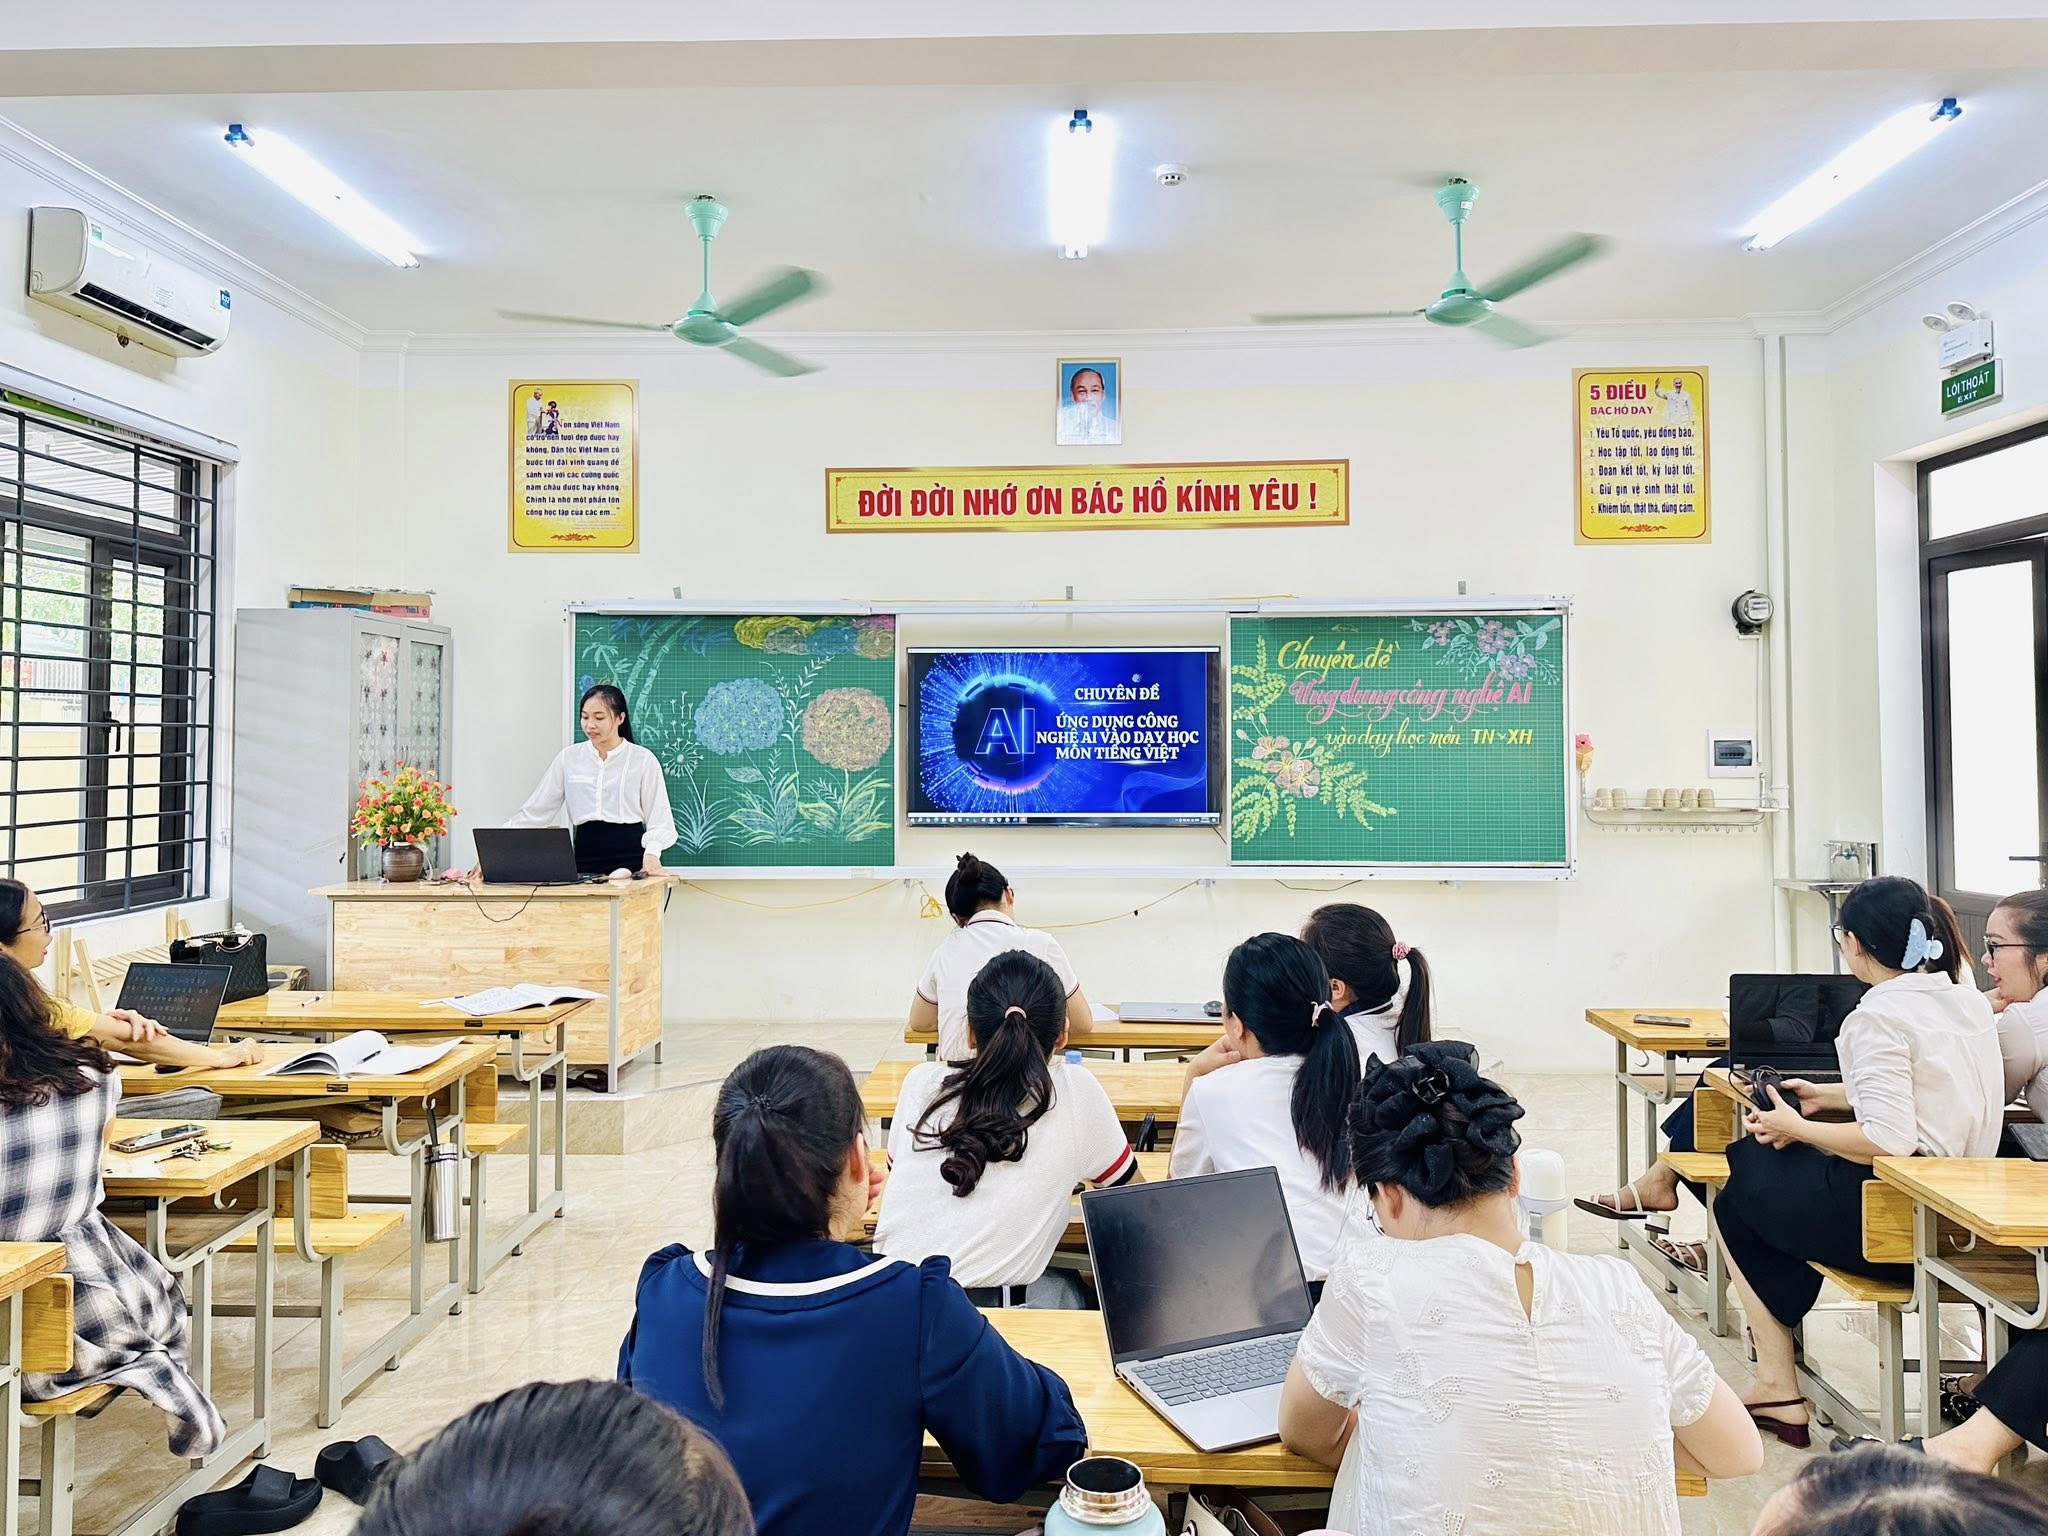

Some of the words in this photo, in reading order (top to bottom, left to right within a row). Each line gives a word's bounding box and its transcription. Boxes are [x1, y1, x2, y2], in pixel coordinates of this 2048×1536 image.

[1590, 385, 1600, 400] 5
[1606, 379, 1646, 400] ĐIỀU
[1958, 391, 1977, 403] EXIT
[1646, 446, 1658, 457] lao
[858, 484, 901, 517] ĐỜI
[910, 483, 954, 517] ĐỜI
[963, 481, 1018, 516] NHỚ
[1026, 485, 1062, 515] ƠN
[1071, 481, 1123, 514] BÁC
[1132, 476, 1168, 514] HỒ
[1176, 479, 1240, 513] KÍNH
[1249, 477, 1299, 511] YÊU
[1645, 483, 1660, 494] sinh
[1364, 638, 1400, 669] đề
[1074, 684, 1137, 701] CHUYÊN
[1139, 683, 1160, 701] ĐỀ
[1506, 682, 1534, 704] AI
[974, 707, 1036, 754] AI
[1056, 711, 1088, 728] ỨNG
[1092, 715, 1134, 732] DỤNG
[1137, 711, 1178, 728] CÔNG
[1325, 726, 1356, 745] vào
[1396, 716, 1425, 748] học
[1430, 724, 1463, 748] môn
[1082, 731, 1097, 744] AI
[1100, 727, 1131, 744] VÀO
[1134, 731, 1165, 747] DẠY
[1168, 731, 1199, 748] HỌC
[1056, 743, 1092, 760] MÔN
[1094, 742, 1141, 760] TIẾNG
[1143, 744, 1179, 763] VIỆT
